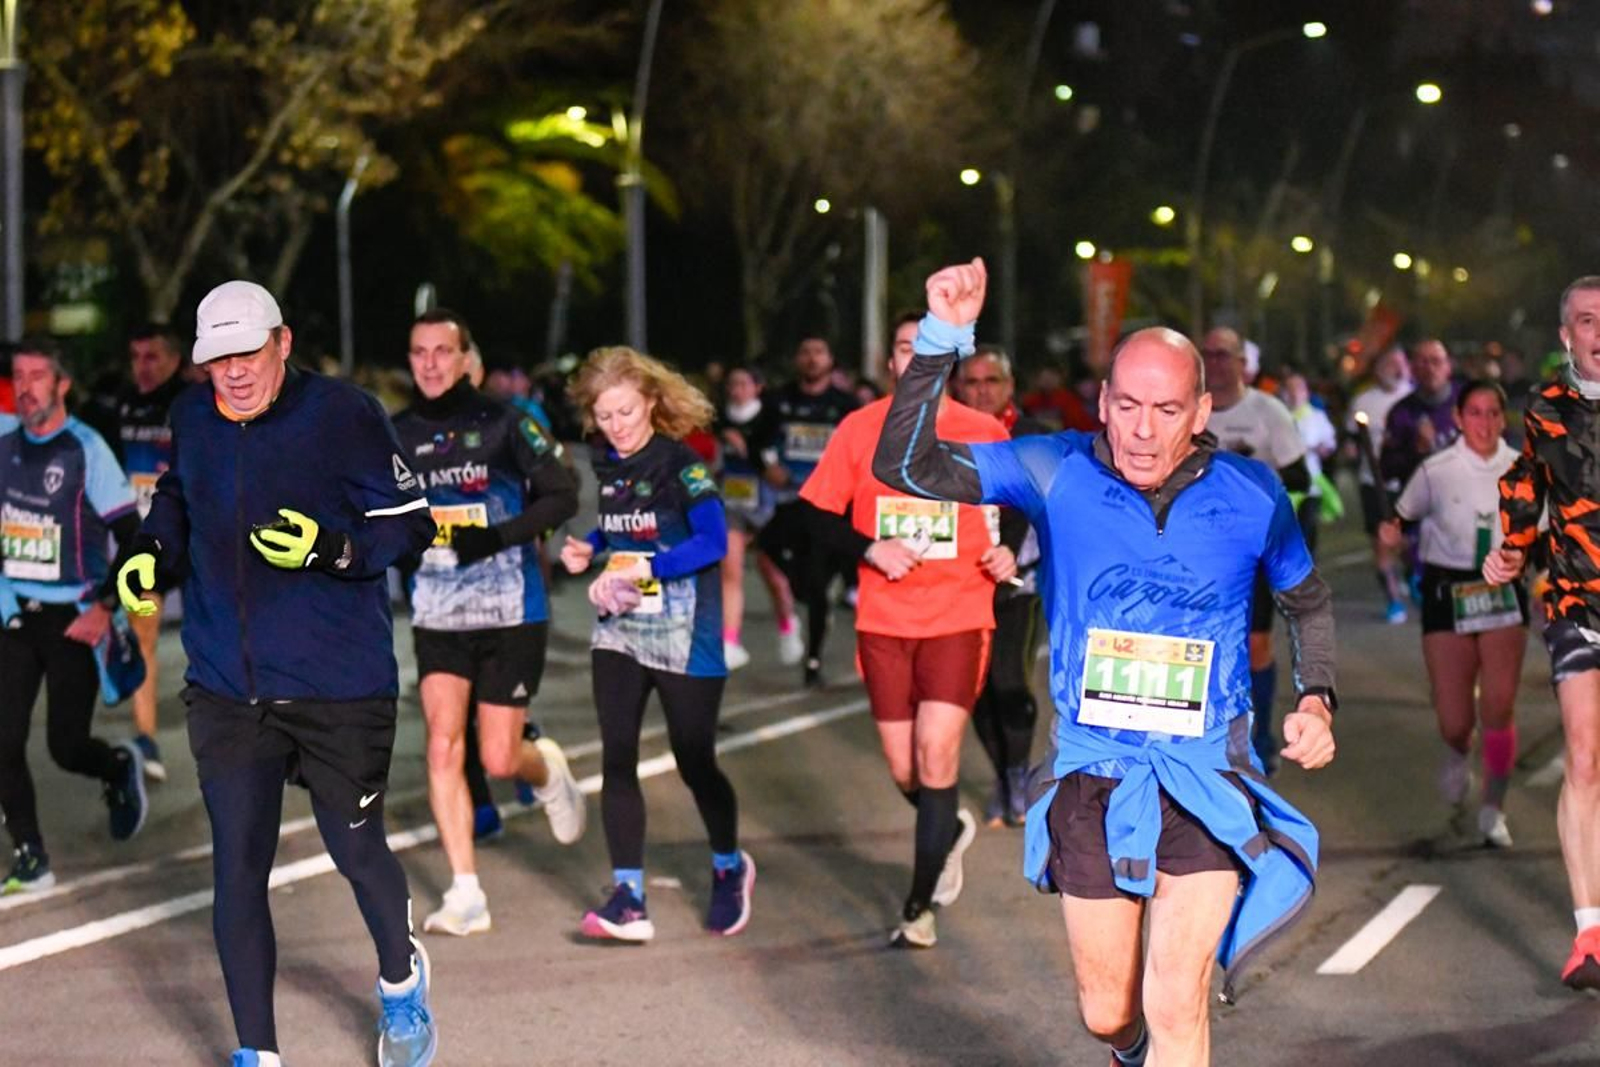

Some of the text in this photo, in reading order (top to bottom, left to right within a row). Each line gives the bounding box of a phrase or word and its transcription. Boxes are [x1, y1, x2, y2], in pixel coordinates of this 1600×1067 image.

[430, 461, 488, 487] ANTÓN
[604, 508, 657, 532] ANTÓN
[1087, 563, 1222, 616] Cazorla
[1095, 657, 1196, 702] 1111
